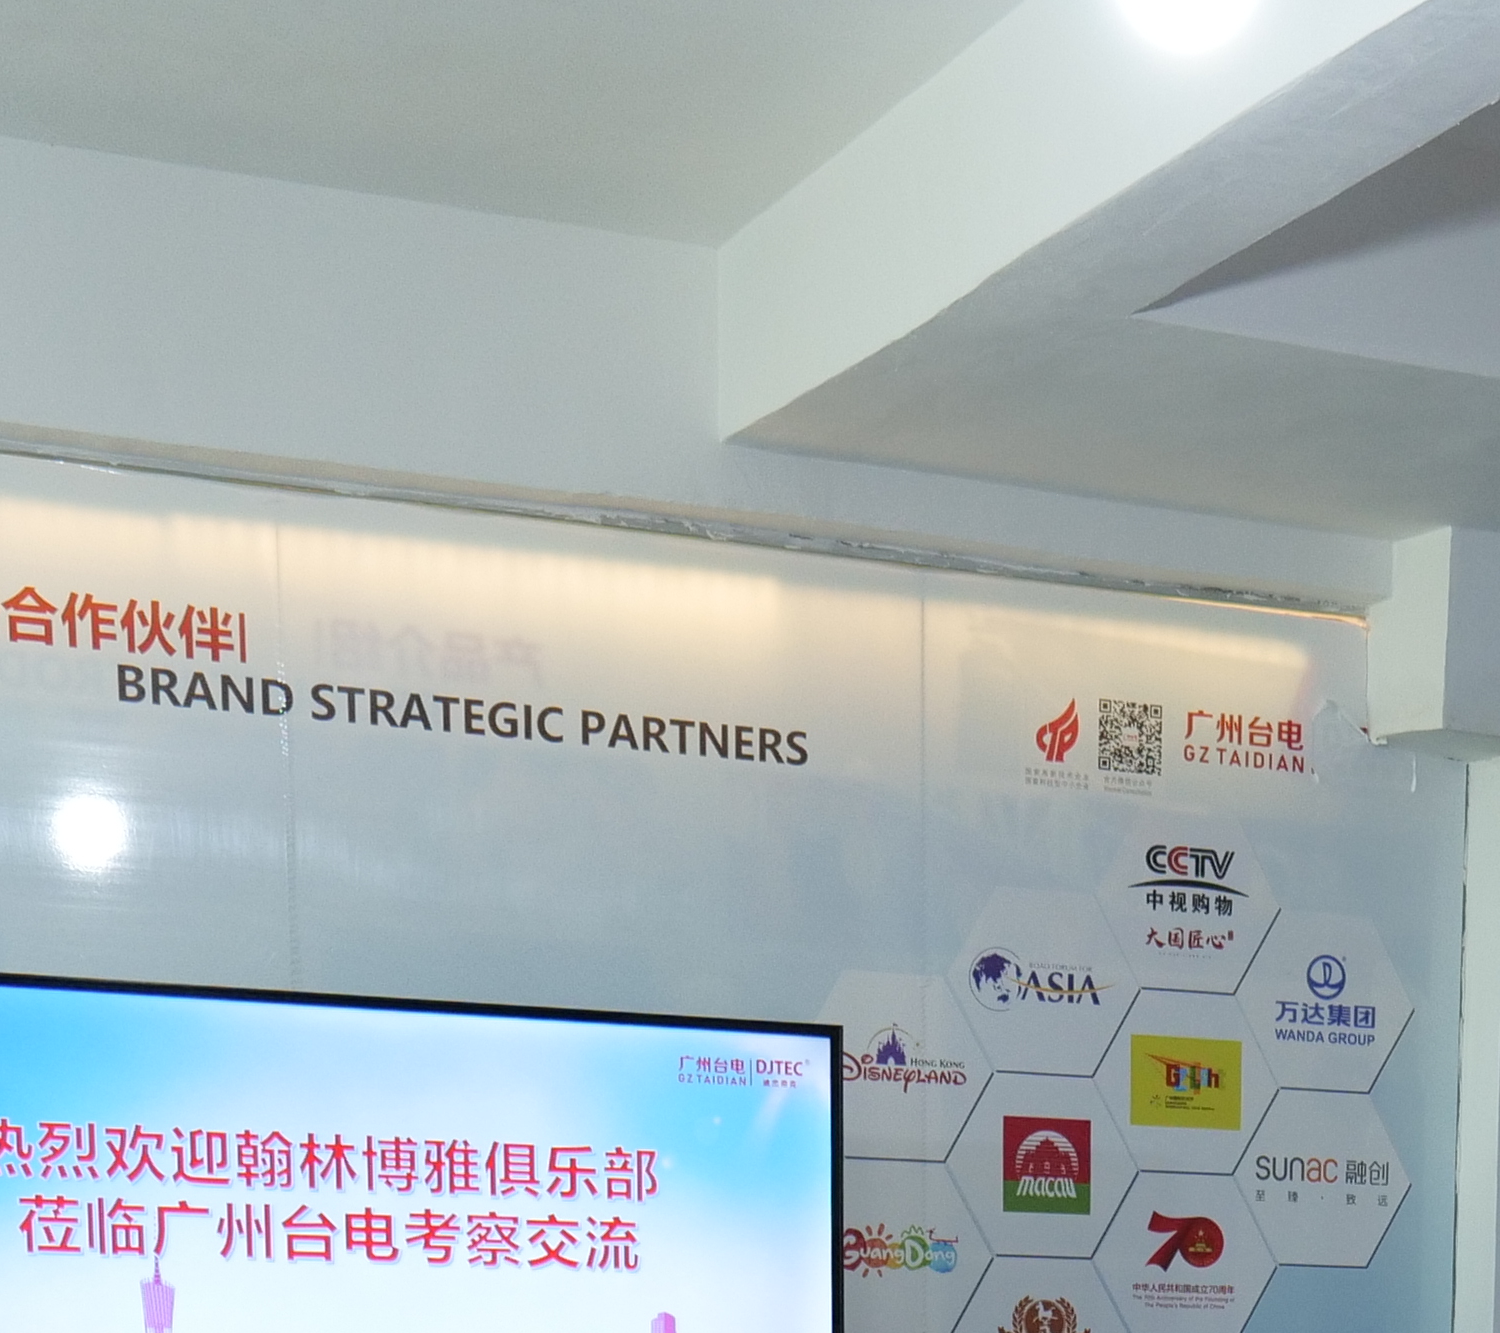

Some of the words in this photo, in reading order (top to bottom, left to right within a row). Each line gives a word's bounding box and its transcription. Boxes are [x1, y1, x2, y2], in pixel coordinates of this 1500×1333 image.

[115, 662, 296, 718] BRAND
[311, 681, 565, 744] STRATEGIC
[578, 709, 810, 767] PARTNERS
[1184, 710, 1304, 751] 广州台电
[1183, 744, 1210, 764] GZ
[1218, 747, 1305, 774] TAIDIAN
[1146, 844, 1235, 879] CCTV
[1146, 889, 1234, 917] 中视购物
[1021, 970, 1101, 1006] ASIA
[1275, 1000, 1376, 1029] 万达集团
[1275, 1028, 1325, 1044] WANDA
[1328, 1030, 1376, 1047] GROUP
[679, 1055, 746, 1075] 广州台电
[756, 1058, 803, 1077] DJTEC
[1345, 1159, 1389, 1186] 融创
[18, 1195, 640, 1270] 莅临广州台电考察交流
